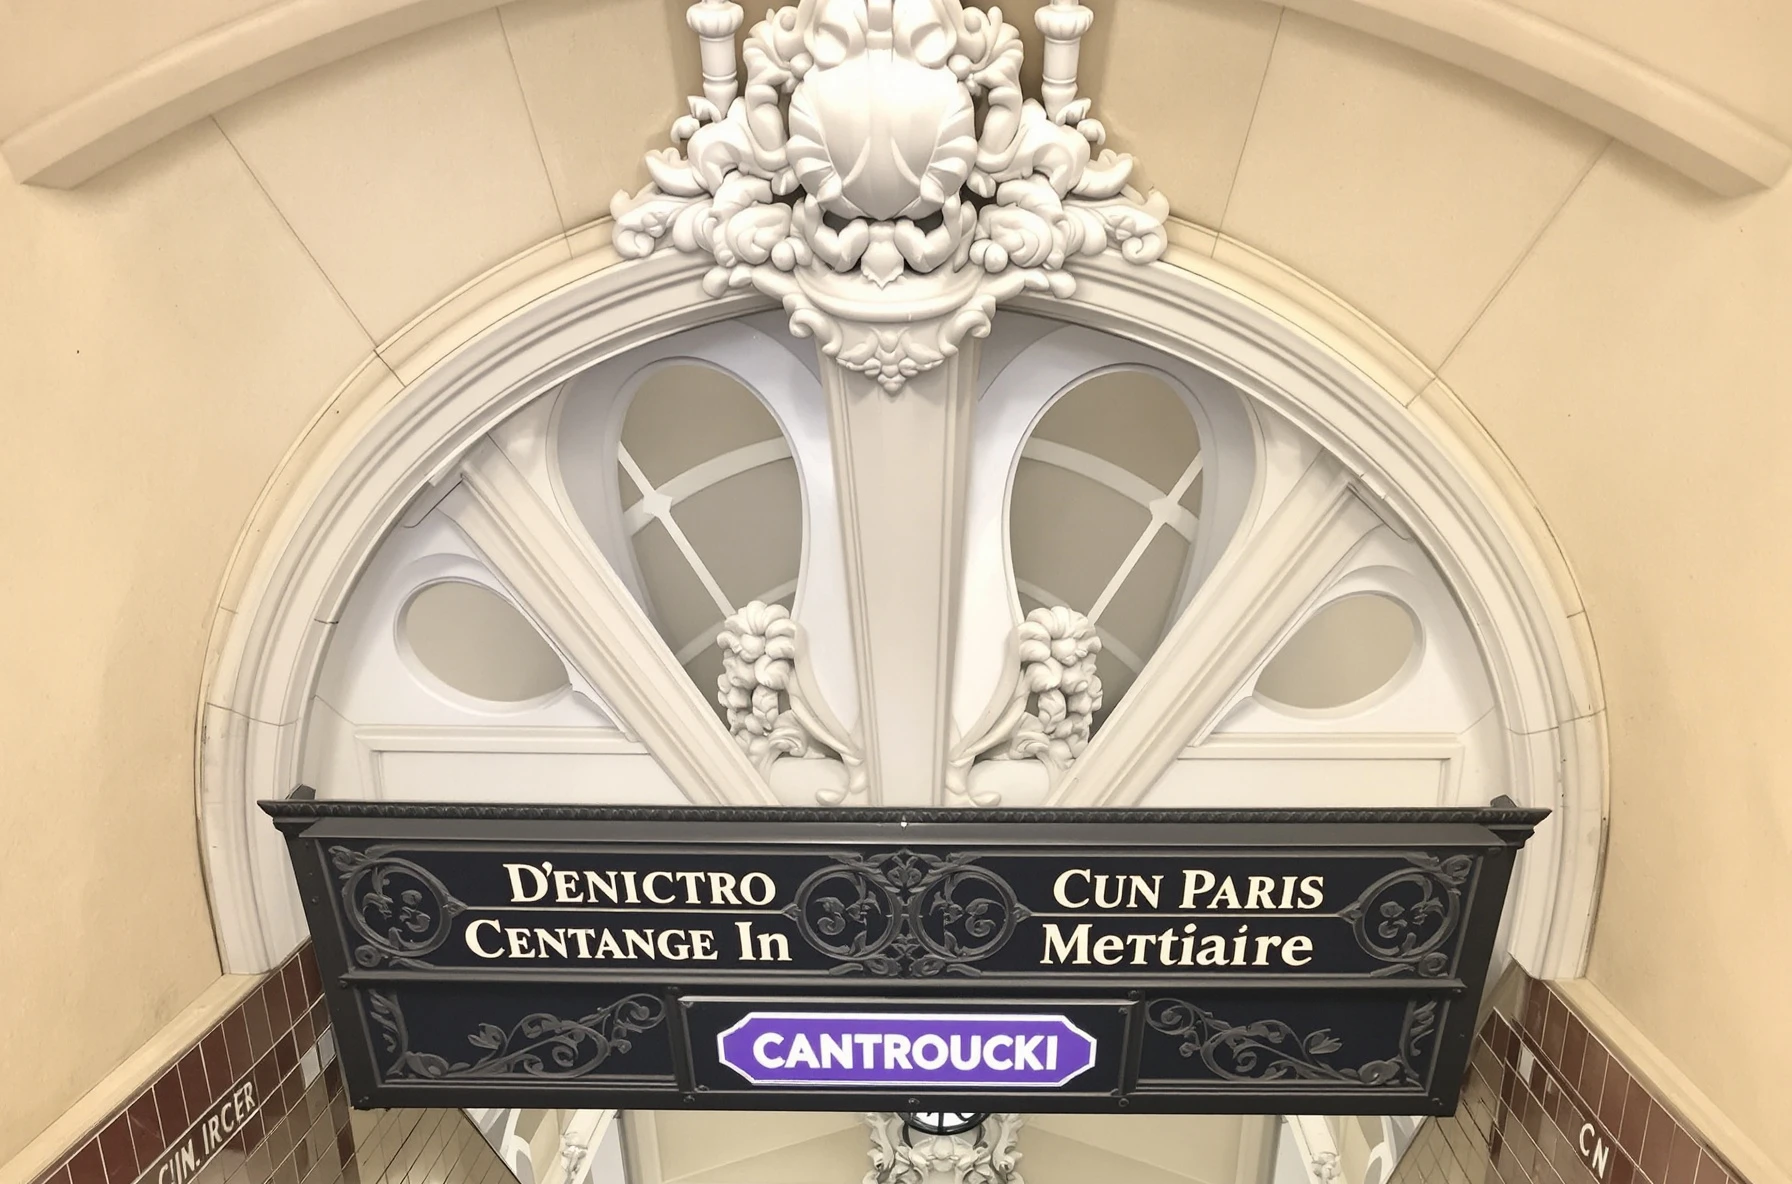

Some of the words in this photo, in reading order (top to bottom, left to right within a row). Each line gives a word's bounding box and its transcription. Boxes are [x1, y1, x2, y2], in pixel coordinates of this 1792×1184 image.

[1053, 868, 1164, 909] CUN
[1179, 869, 1324, 909] PARIS
[465, 919, 718, 960] CENTANGE
[734, 921, 793, 961] In
[752, 1032, 1058, 1071] CANTROUCKI
